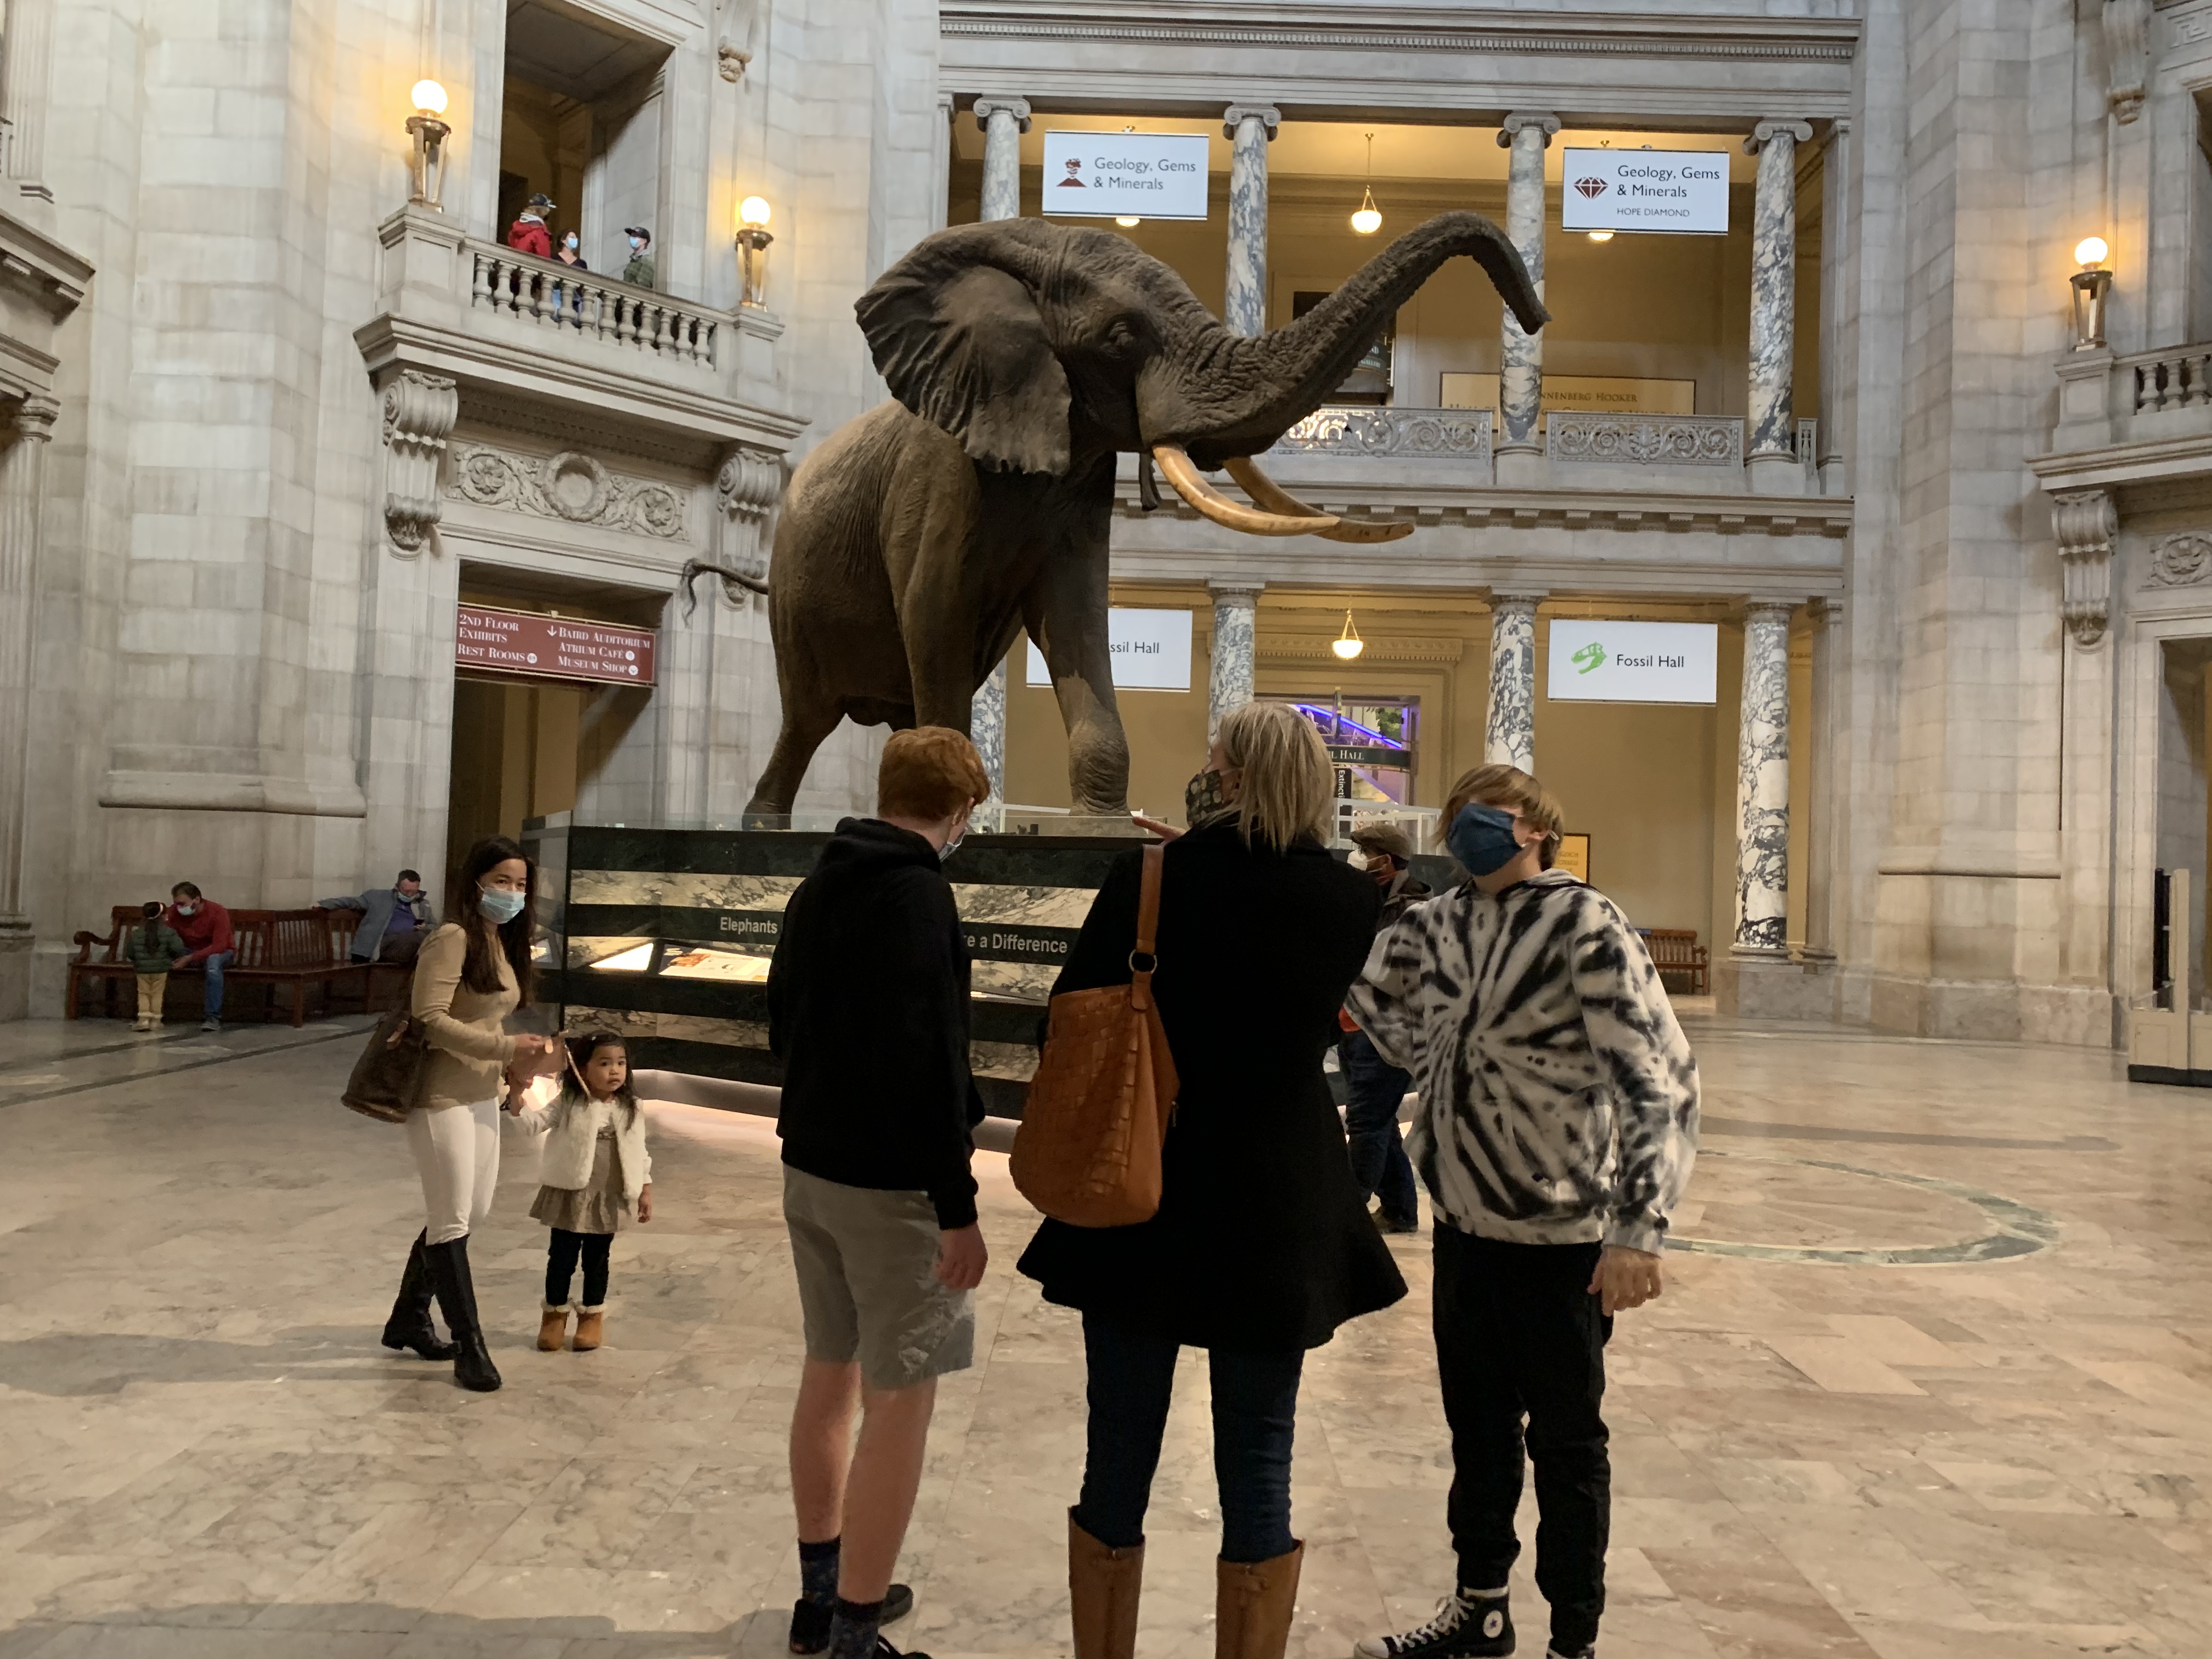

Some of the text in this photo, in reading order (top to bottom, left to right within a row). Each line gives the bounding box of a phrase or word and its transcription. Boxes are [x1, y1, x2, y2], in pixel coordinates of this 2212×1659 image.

[1094, 157, 1196, 174] Geology, Gems
[1618, 165, 1720, 182] Geology, Gems
[1093, 176, 1164, 190] & Minerals
[1617, 184, 1687, 198] & Minerals
[1617, 207, 1690, 217] HOPE DIAMOND
[1541, 392, 1638, 402] NNENBERG HOOKER
[485, 616, 519, 631] FLOOR
[459, 627, 507, 643] EXHIBITS
[458, 643, 525, 662] REST ROOMS
[1109, 641, 1159, 653] ssil Hall
[602, 660, 627, 673] SHOP
[1617, 654, 1684, 668] Fossil Hall
[1340, 749, 1364, 760] HALL
[1338, 770, 1346, 798] Extincti
[720, 917, 778, 935] Elephants
[979, 936, 988, 948] a
[992, 933, 1068, 953] Difference
